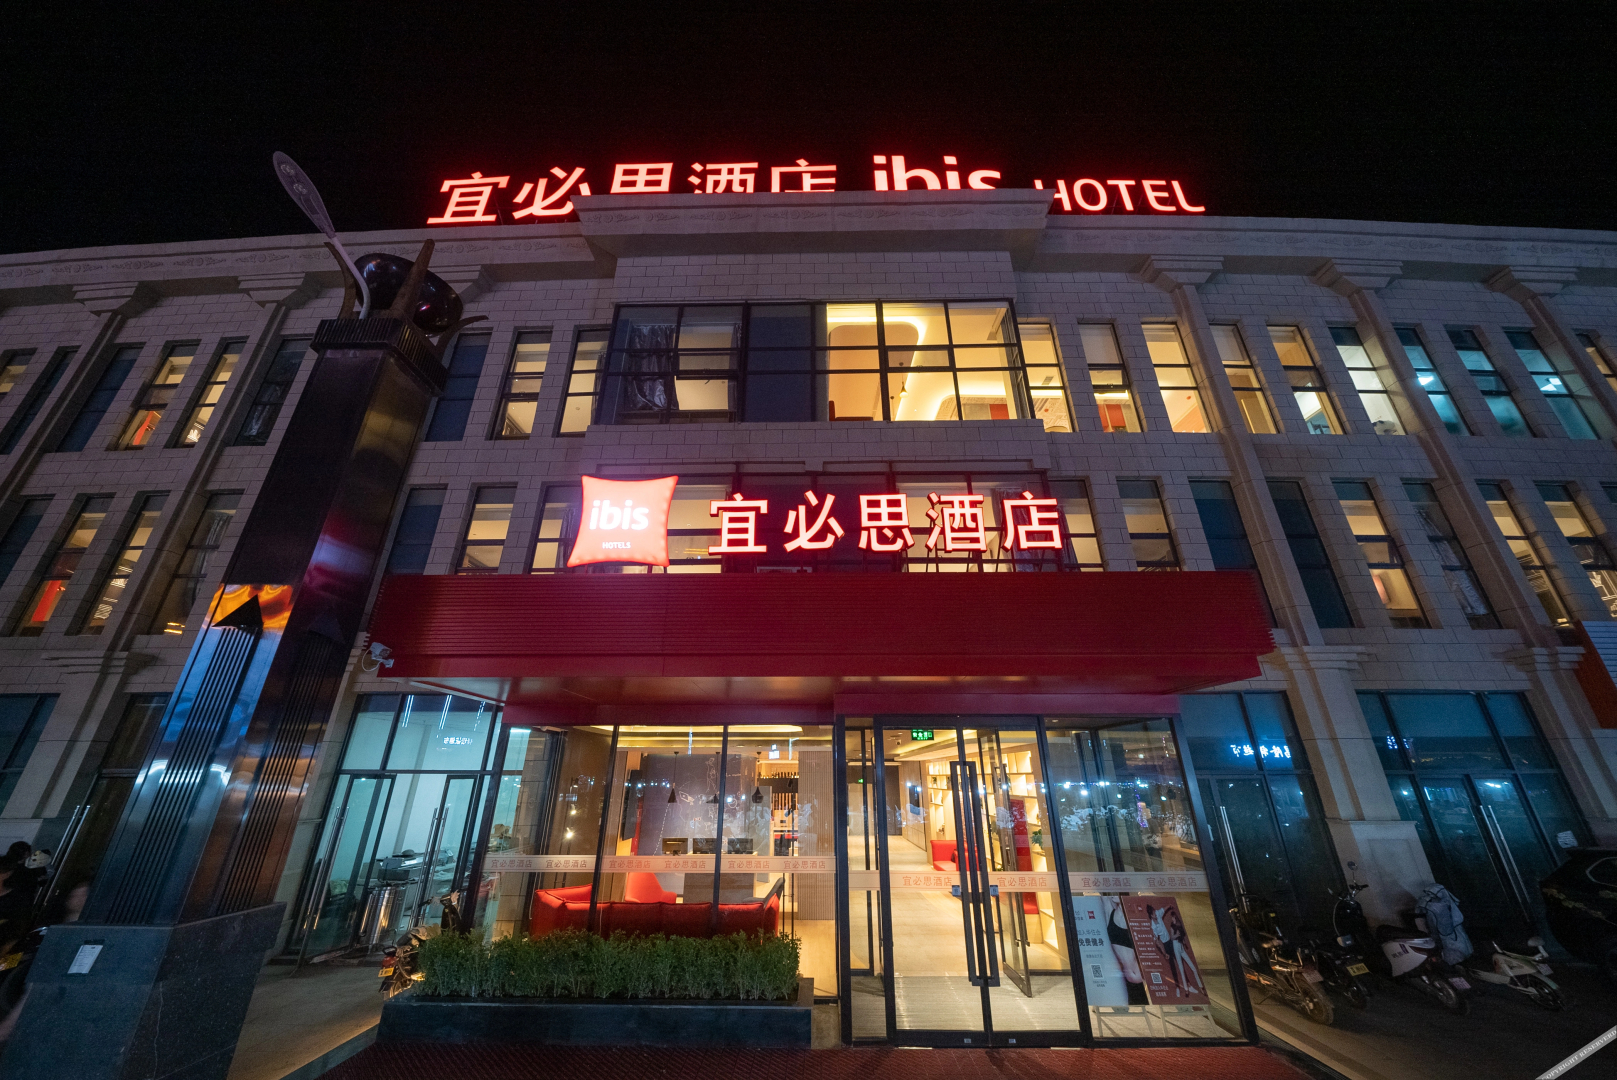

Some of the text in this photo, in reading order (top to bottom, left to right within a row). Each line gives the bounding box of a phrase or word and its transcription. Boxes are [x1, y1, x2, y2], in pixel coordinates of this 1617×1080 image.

[1033, 178, 1206, 213] HOTEL
[589, 499, 650, 531] ibis
[708, 489, 1063, 554] 宜必思酒店
[602, 541, 631, 549] HOTELS
[491, 859, 588, 868] 宜必思酒店 宜必思酒店
[608, 859, 707, 869] 宜必思酒店 宜必思酒店
[727, 860, 826, 870] 宜必思酒店 宜必思酒店
[902, 875, 953, 887] 宜必思酒店
[996, 876, 1048, 888] 宜必思酒店
[1081, 876, 1198, 888] 宜必思酒店 宜必思酒店
